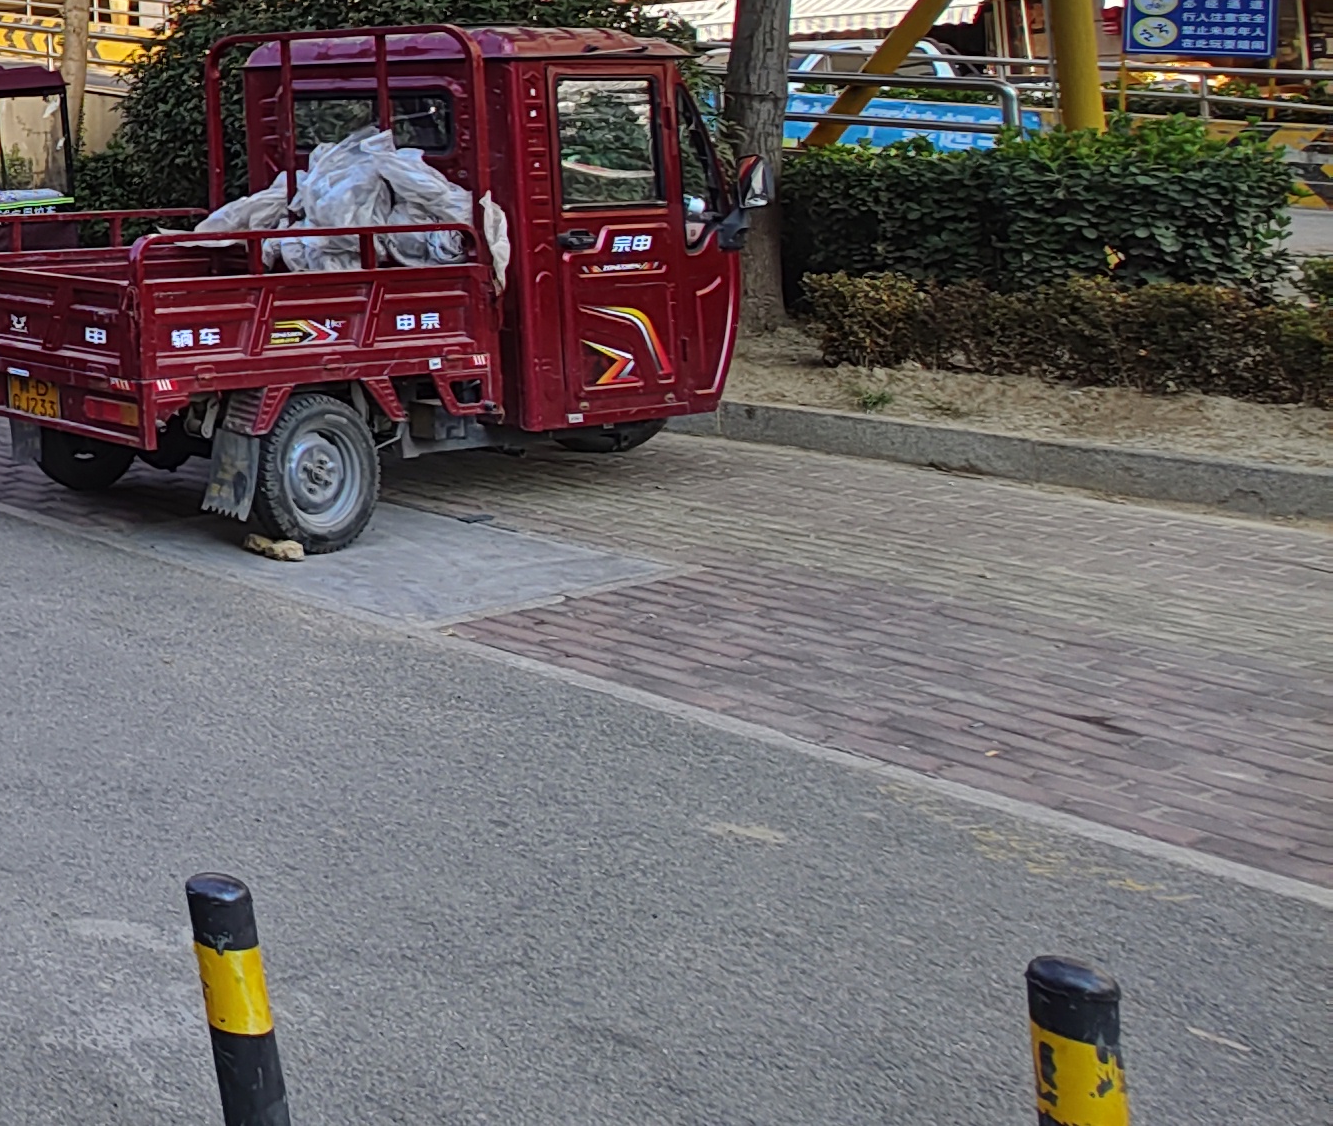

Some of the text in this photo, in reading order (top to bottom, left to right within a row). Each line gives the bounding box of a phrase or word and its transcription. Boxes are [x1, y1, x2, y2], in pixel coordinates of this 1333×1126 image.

[1182, 0, 1265, 10] 必经通道
[1182, 13, 1266, 24] 行人注意安全
[1182, 26, 1266, 37] 禁止未成年人
[611, 235, 653, 253] 宗申
[85, 326, 107, 344] 申
